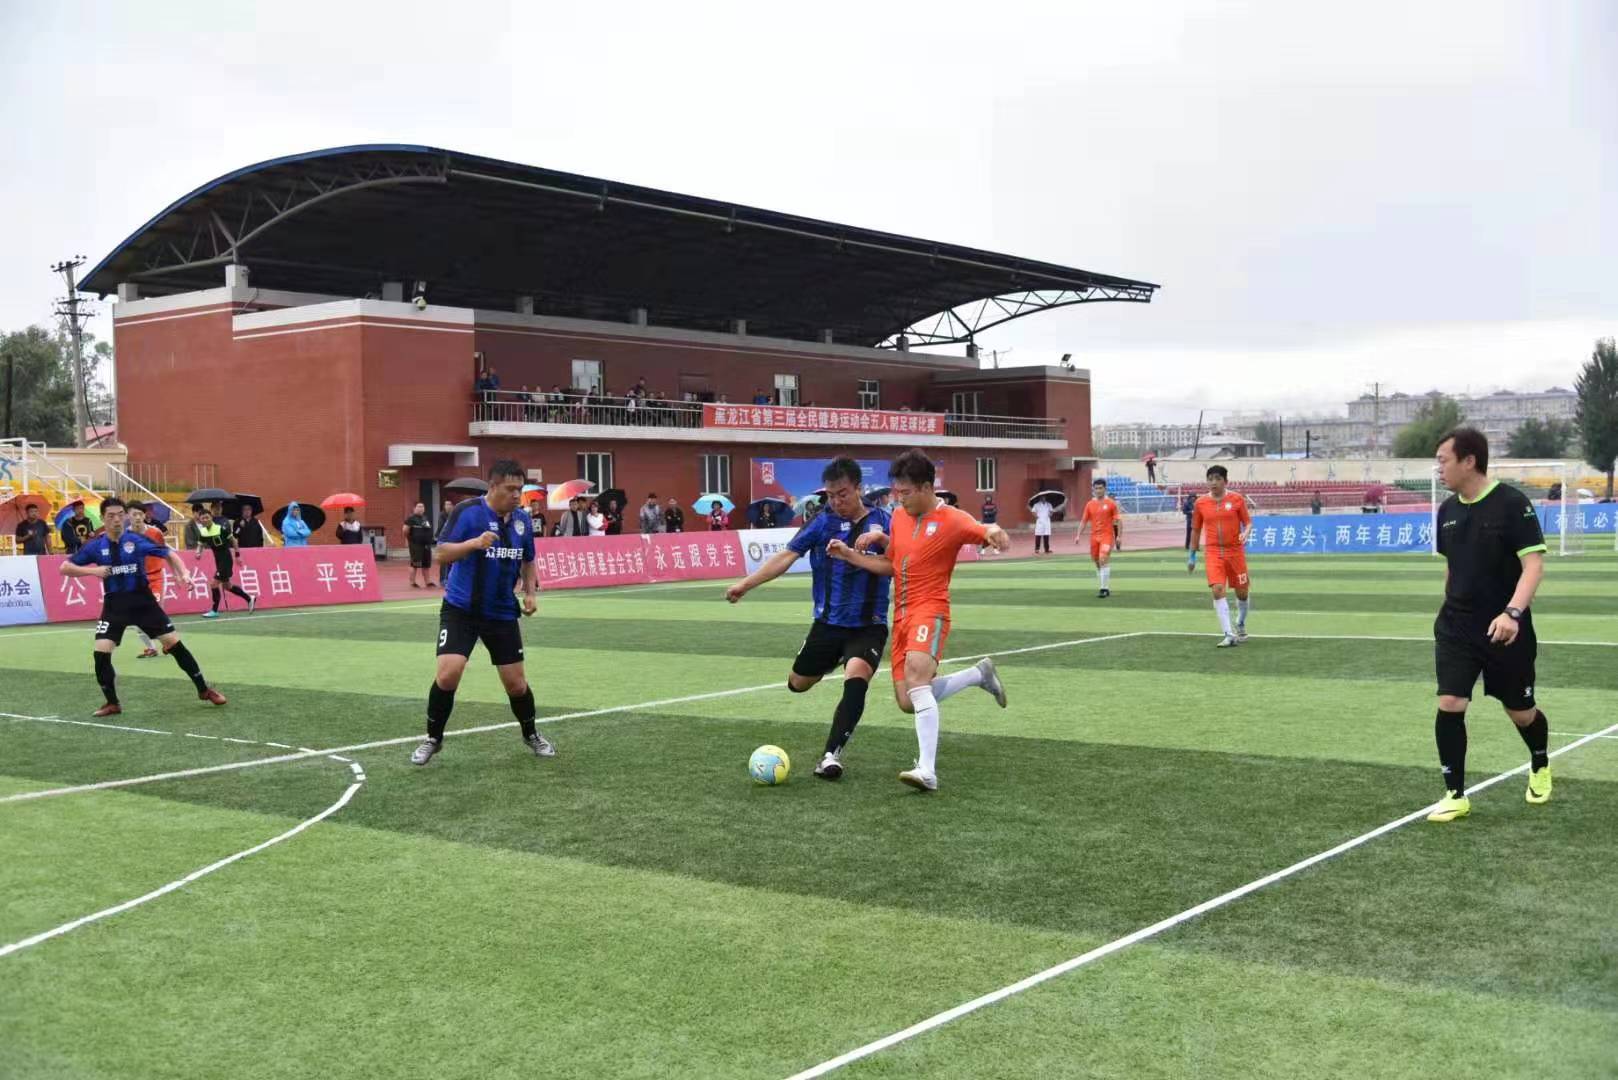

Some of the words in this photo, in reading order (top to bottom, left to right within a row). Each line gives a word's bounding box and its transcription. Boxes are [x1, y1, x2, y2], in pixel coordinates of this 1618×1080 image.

[537, 548, 644, 577] 中国足球发展基金会支持
[654, 544, 737, 570] 永远跟党走
[239, 563, 293, 596] 自由
[316, 560, 367, 592] 平等
[439, 629, 448, 646] 9
[916, 625, 929, 642] 9
